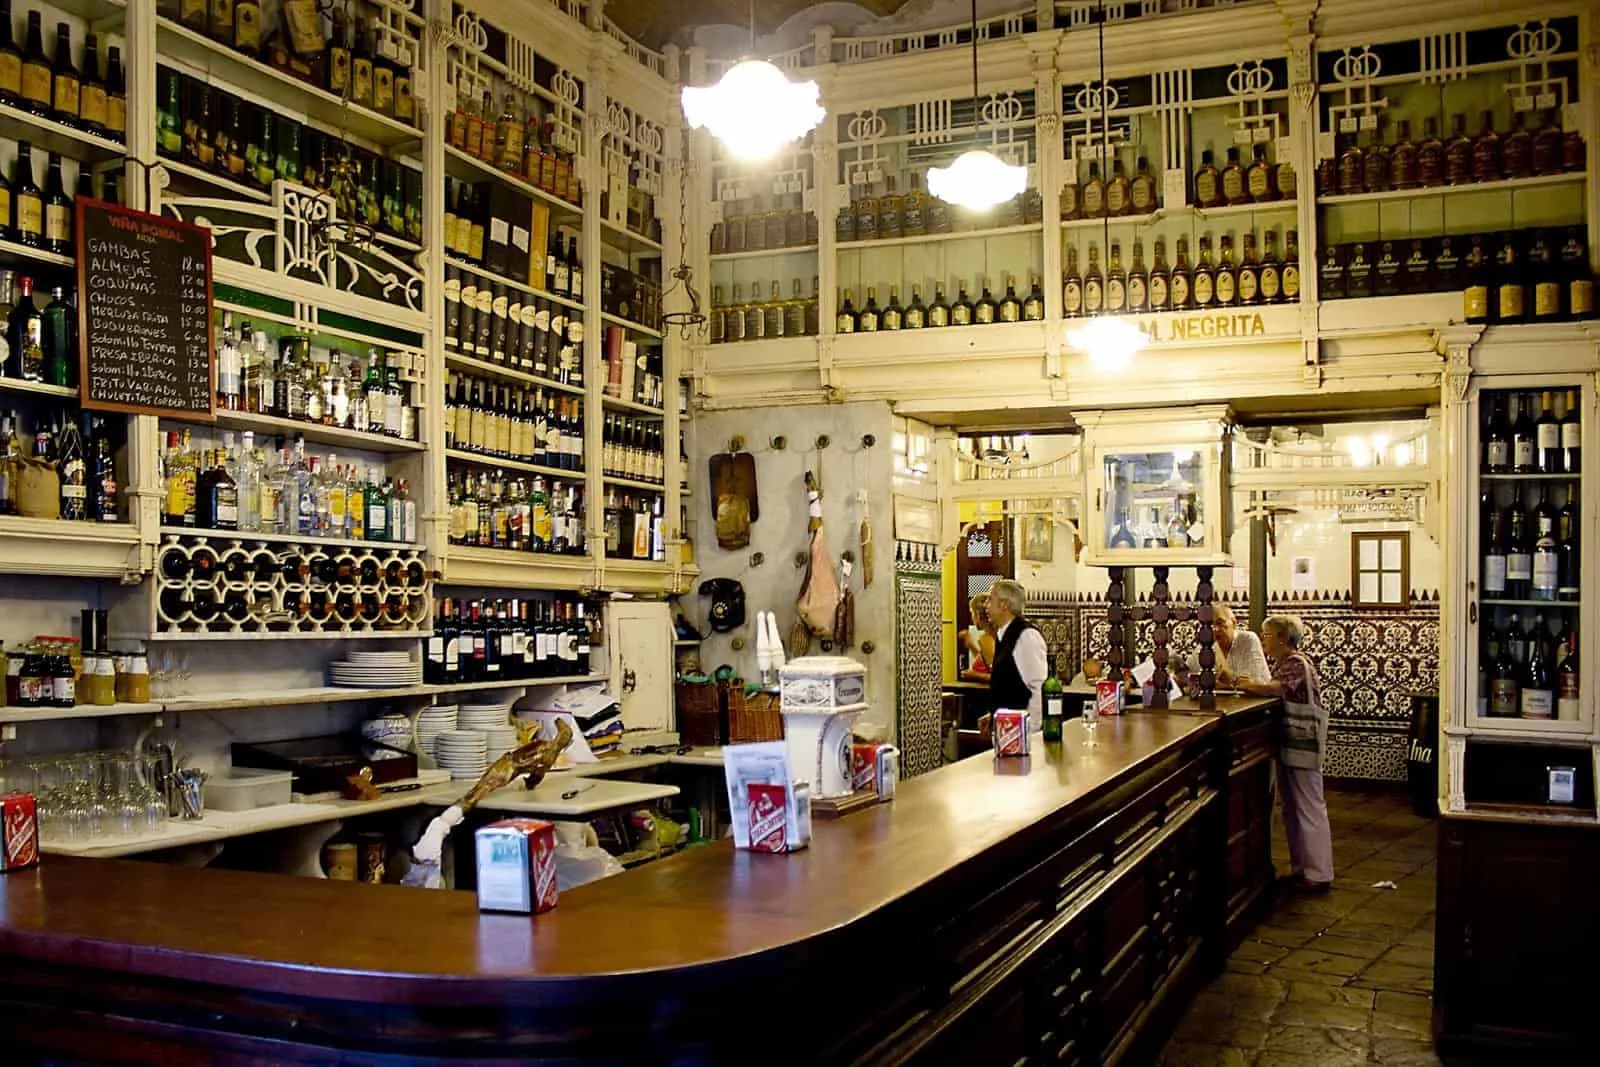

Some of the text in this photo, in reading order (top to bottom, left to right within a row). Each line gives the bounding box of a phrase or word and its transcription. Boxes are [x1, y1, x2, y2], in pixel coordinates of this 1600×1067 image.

[88, 238, 151, 264] GAMBAS
[91, 257, 152, 280] ALMEJAS
[89, 274, 157, 295] COQUINAS
[89, 291, 136, 307] CHOCOS
[1171, 313, 1265, 340] NEGRITA
